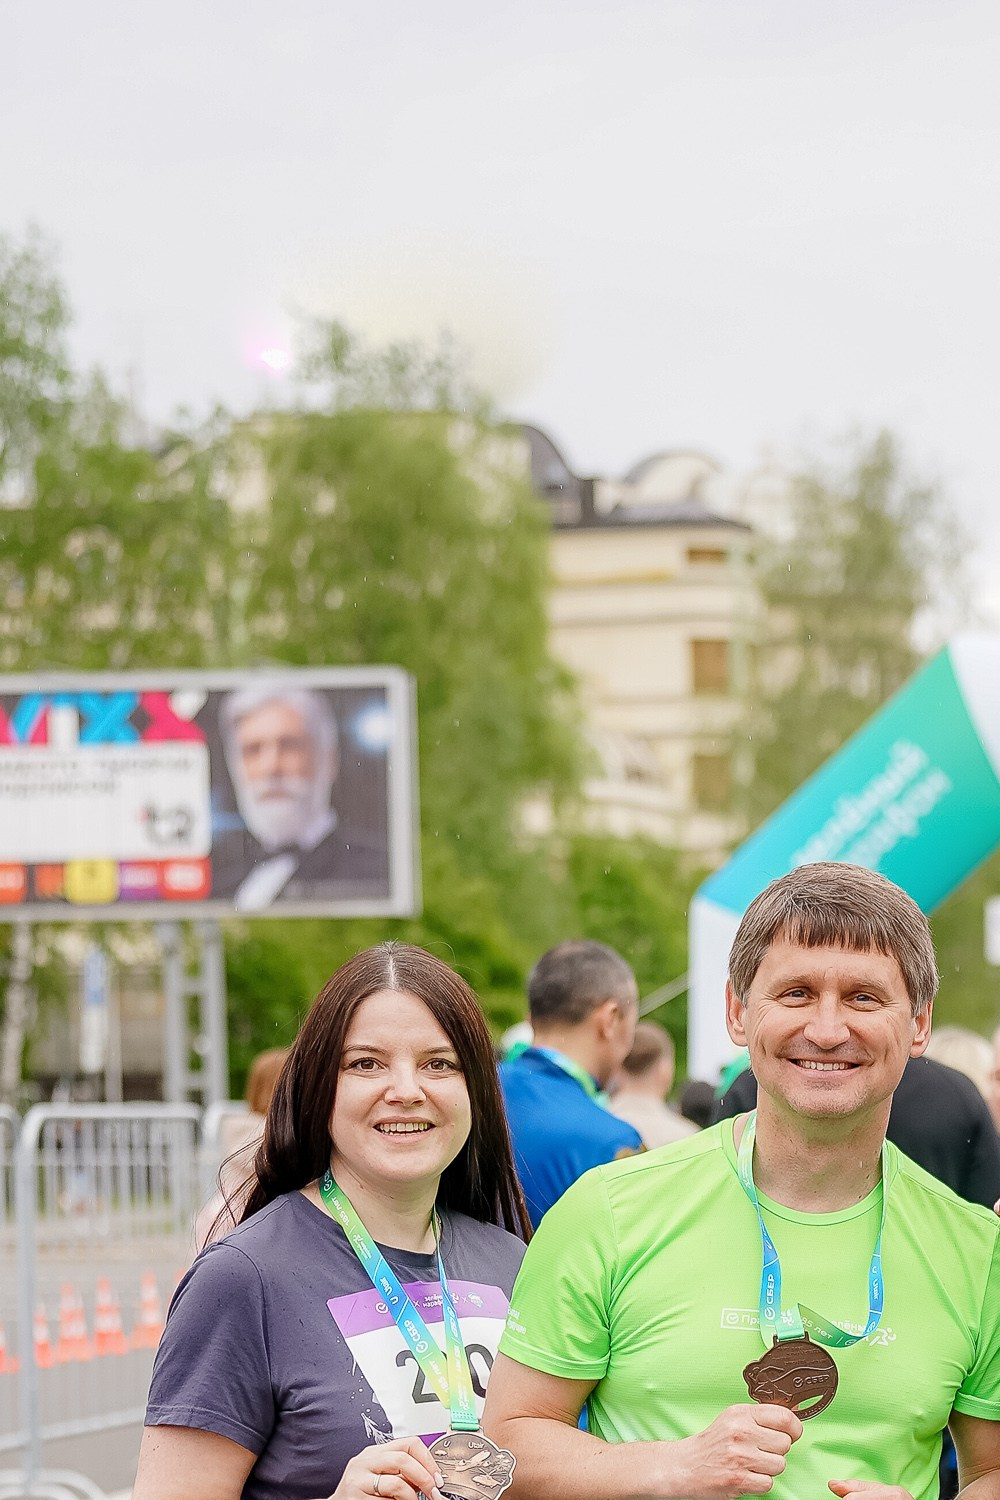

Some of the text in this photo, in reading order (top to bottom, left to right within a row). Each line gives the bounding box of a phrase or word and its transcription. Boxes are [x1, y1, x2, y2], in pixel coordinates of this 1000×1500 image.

[765, 1273, 775, 1305] СБЕР
[403, 1319, 421, 1341] СБЕР
[741, 1313, 760, 1326] Пра
[802, 1316, 833, 1340] 85 лет
[468, 1441, 486, 1449] Utair
